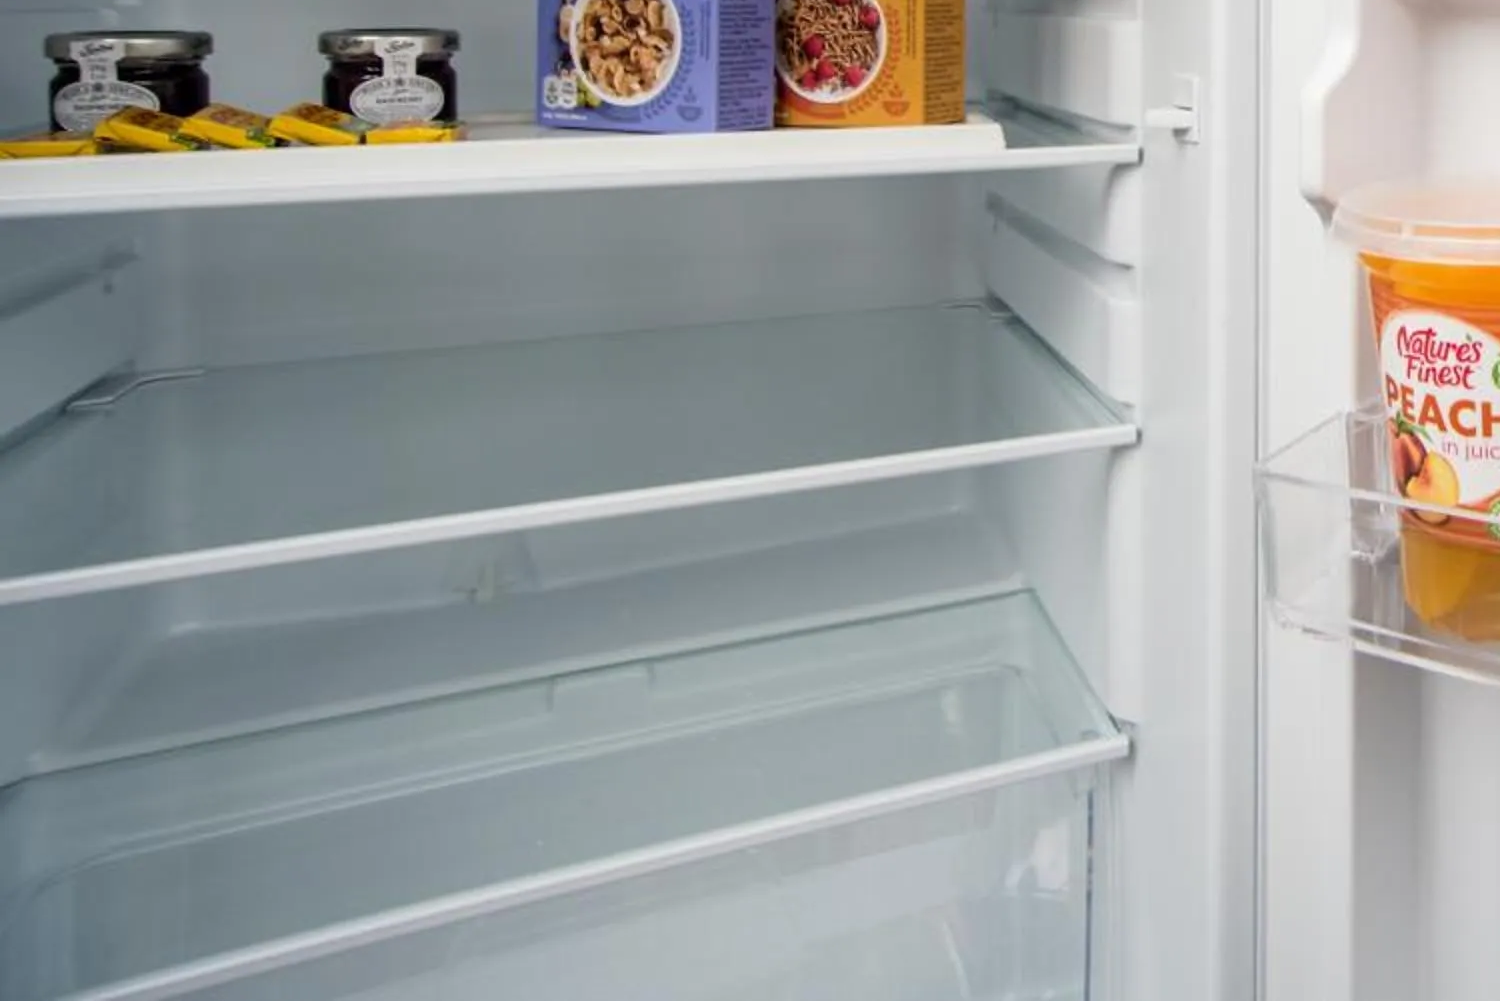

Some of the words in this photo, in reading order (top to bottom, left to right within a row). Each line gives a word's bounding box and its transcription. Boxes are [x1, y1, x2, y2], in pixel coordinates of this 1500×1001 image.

[1396, 325, 1483, 365] Nature's
[1404, 353, 1477, 390] Finest
[1441, 439, 1459, 457] in
